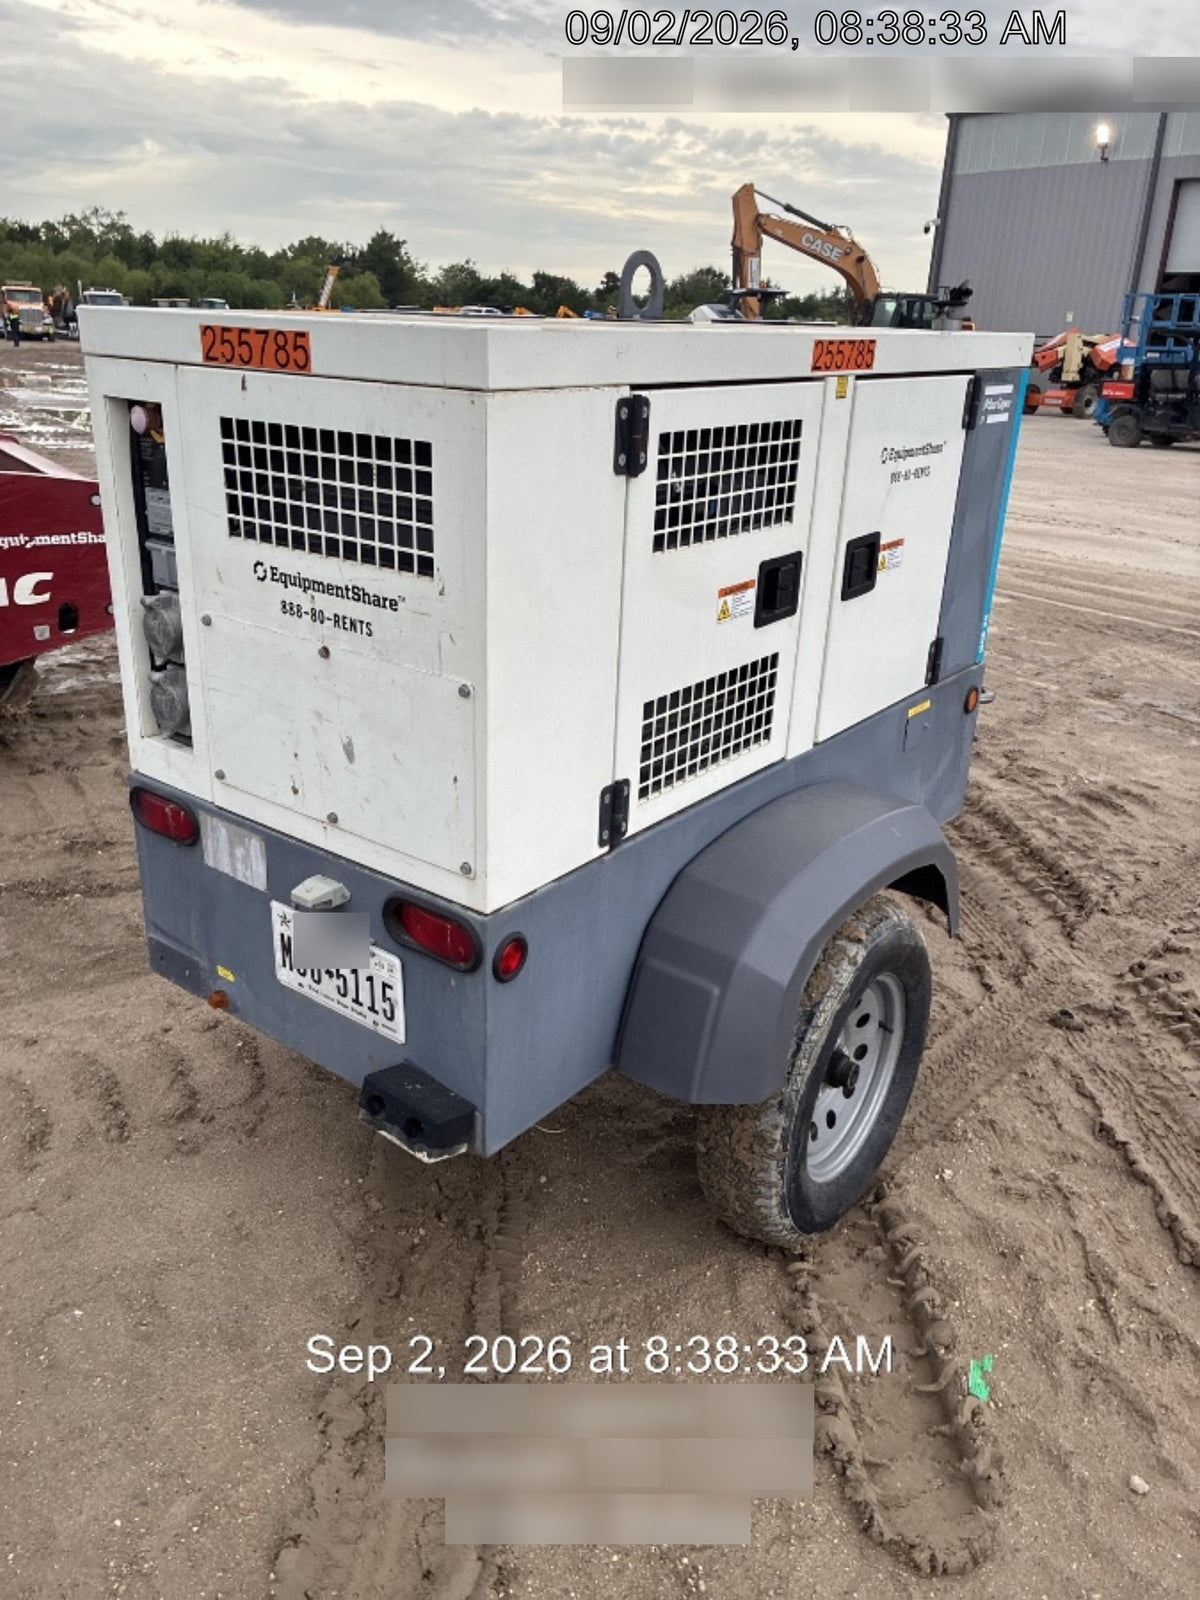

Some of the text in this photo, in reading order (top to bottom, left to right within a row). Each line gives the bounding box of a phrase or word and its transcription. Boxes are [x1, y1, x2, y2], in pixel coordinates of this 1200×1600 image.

[801, 233, 841, 261] CASE
[203, 325, 309, 370] 255785
[812, 340, 876, 370] 255785
[269, 565, 398, 612] EquipmentShare
[280, 600, 373, 637] 888-80-RENTS
